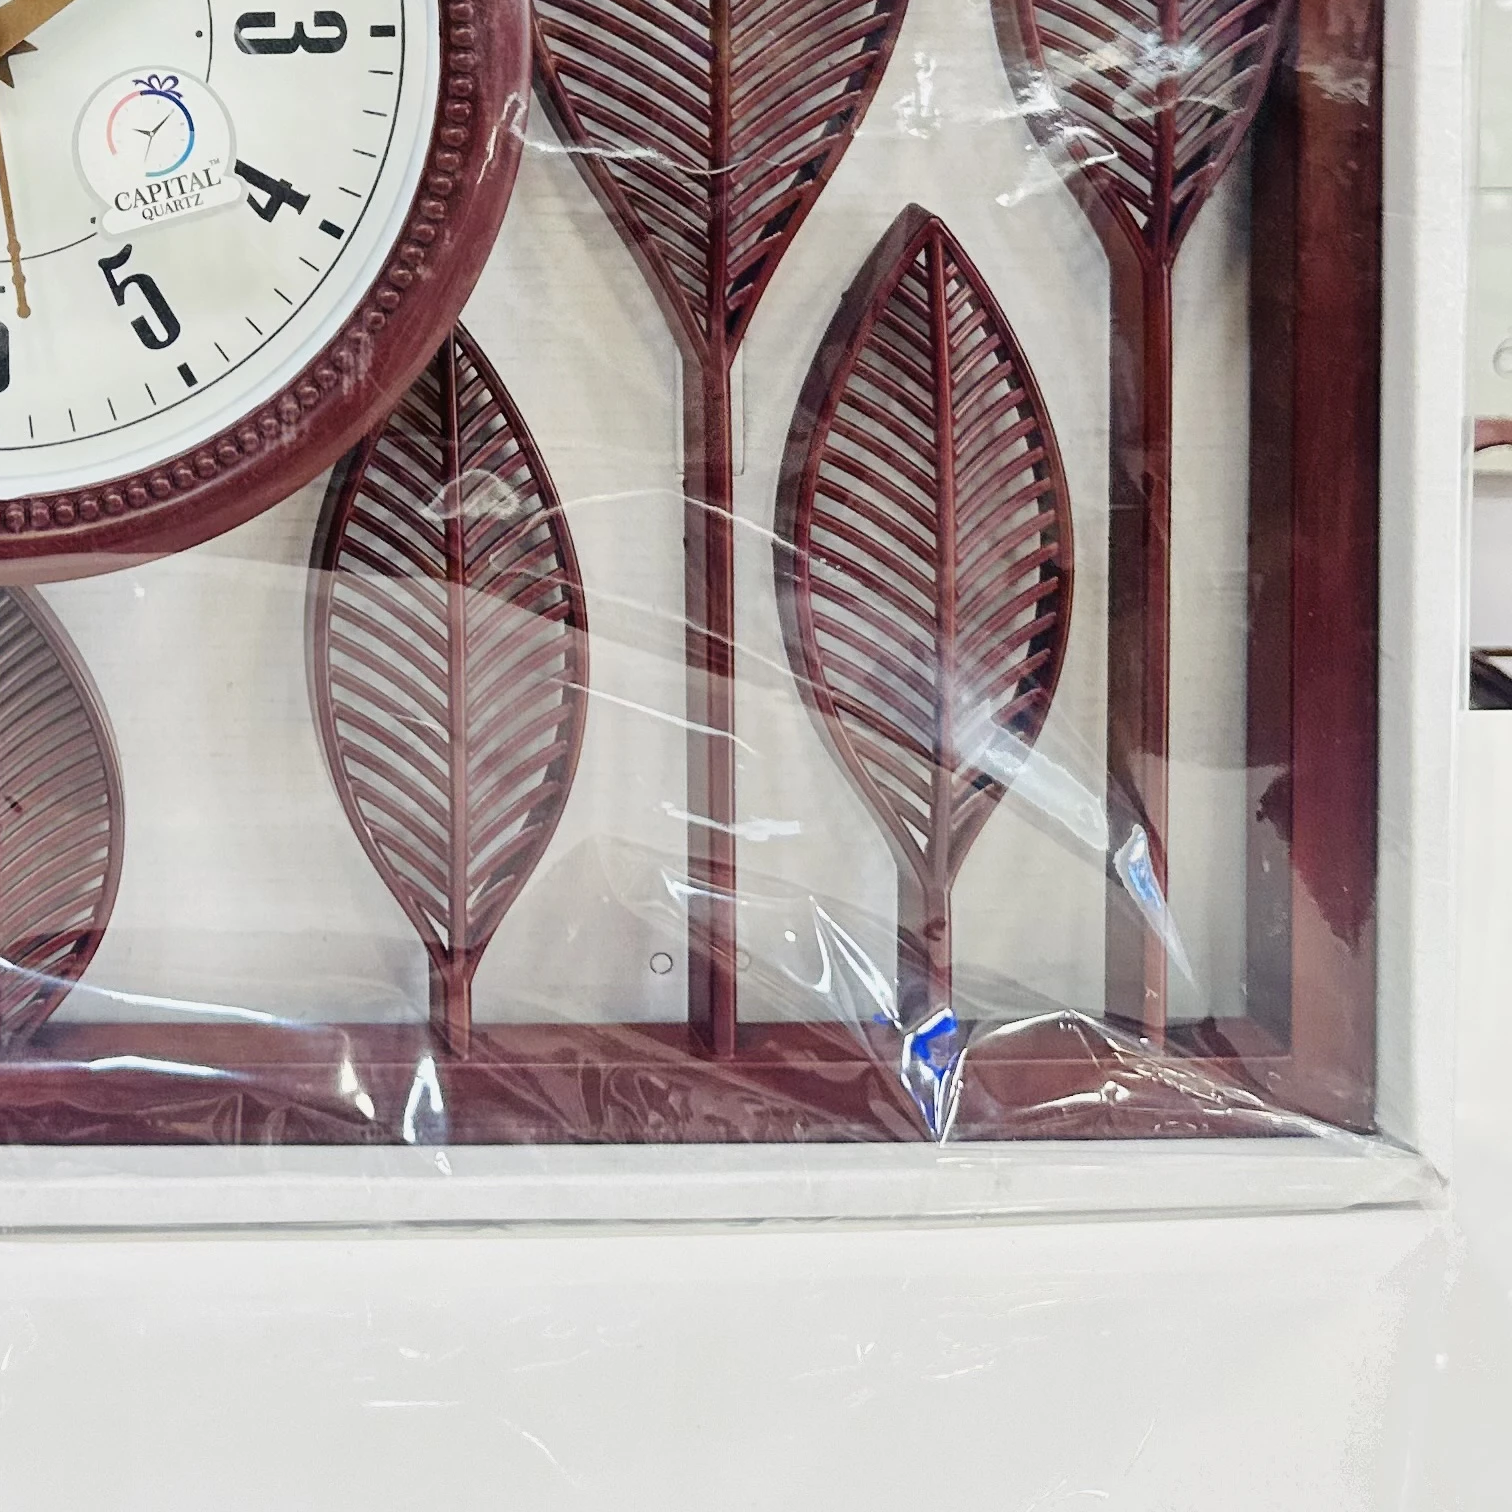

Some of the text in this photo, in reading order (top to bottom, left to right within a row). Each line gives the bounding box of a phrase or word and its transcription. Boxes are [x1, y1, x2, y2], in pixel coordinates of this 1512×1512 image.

[234, 10, 348, 55] 3
[114, 167, 222, 213] CAPITAL
[141, 192, 204, 221] QUARTZ
[233, 159, 311, 223] 4
[97, 243, 181, 350] 5
